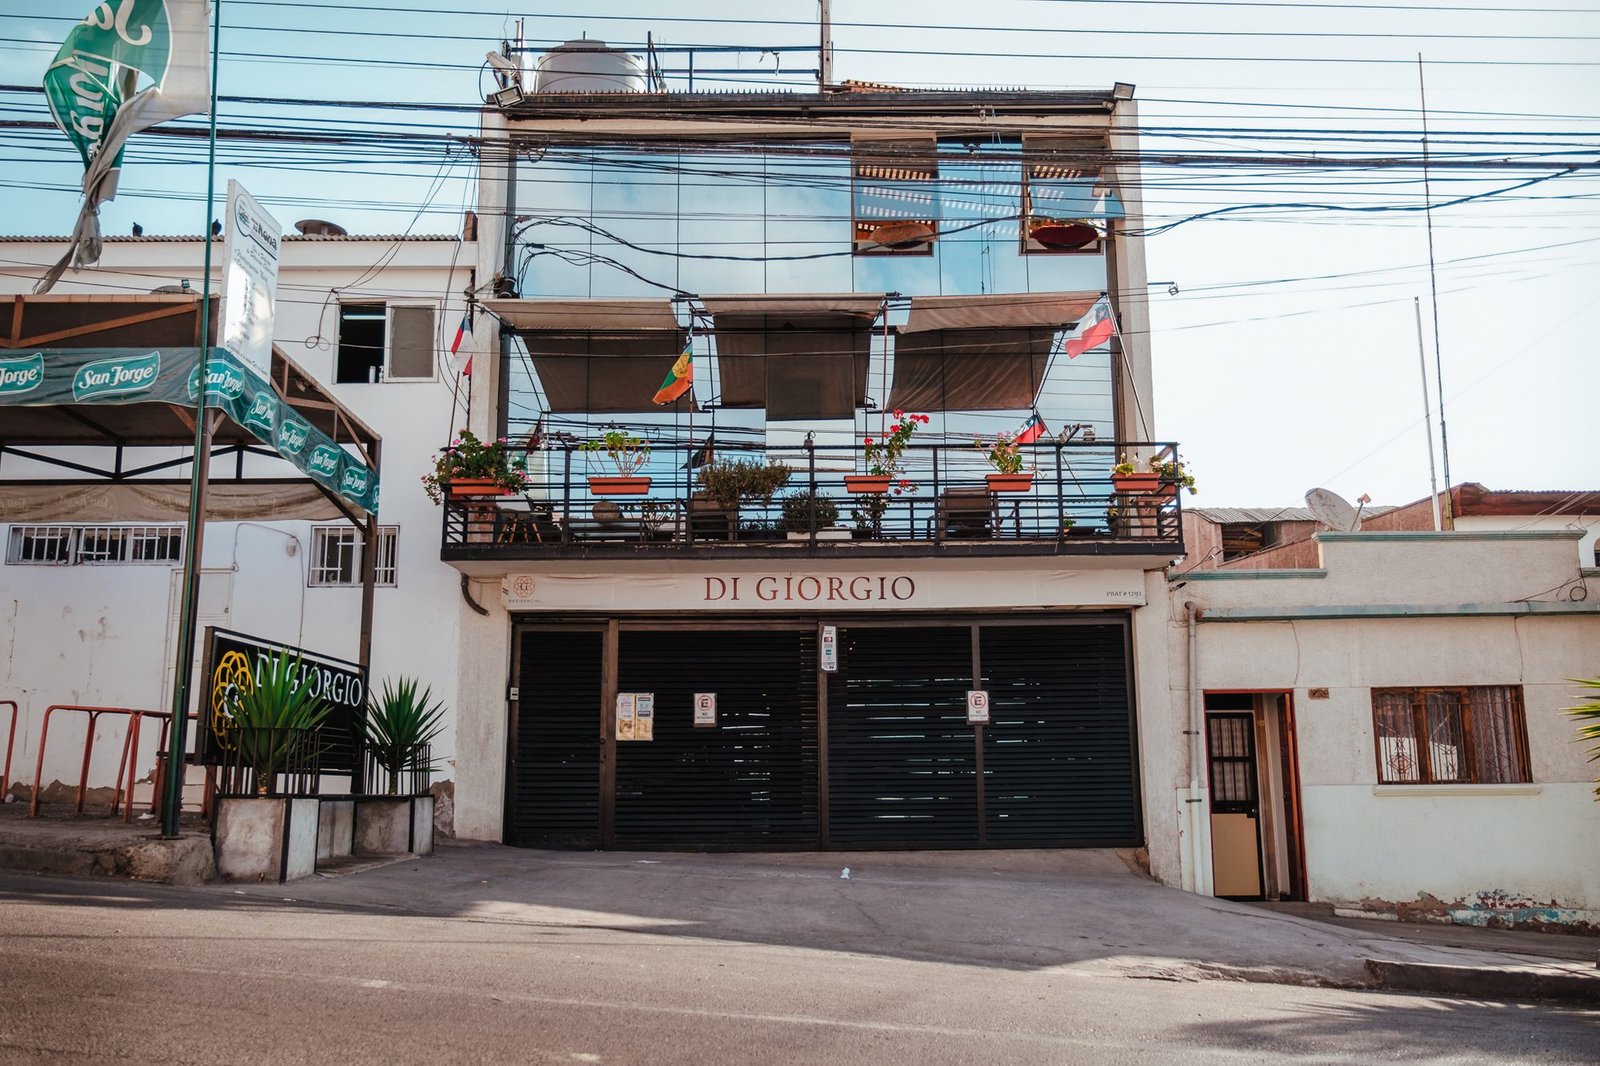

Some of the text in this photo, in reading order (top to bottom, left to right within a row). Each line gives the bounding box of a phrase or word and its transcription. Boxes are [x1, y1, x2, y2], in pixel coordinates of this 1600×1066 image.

[78, 366, 153, 389] San Jorge
[704, 575, 916, 601] DI GIORGIO
